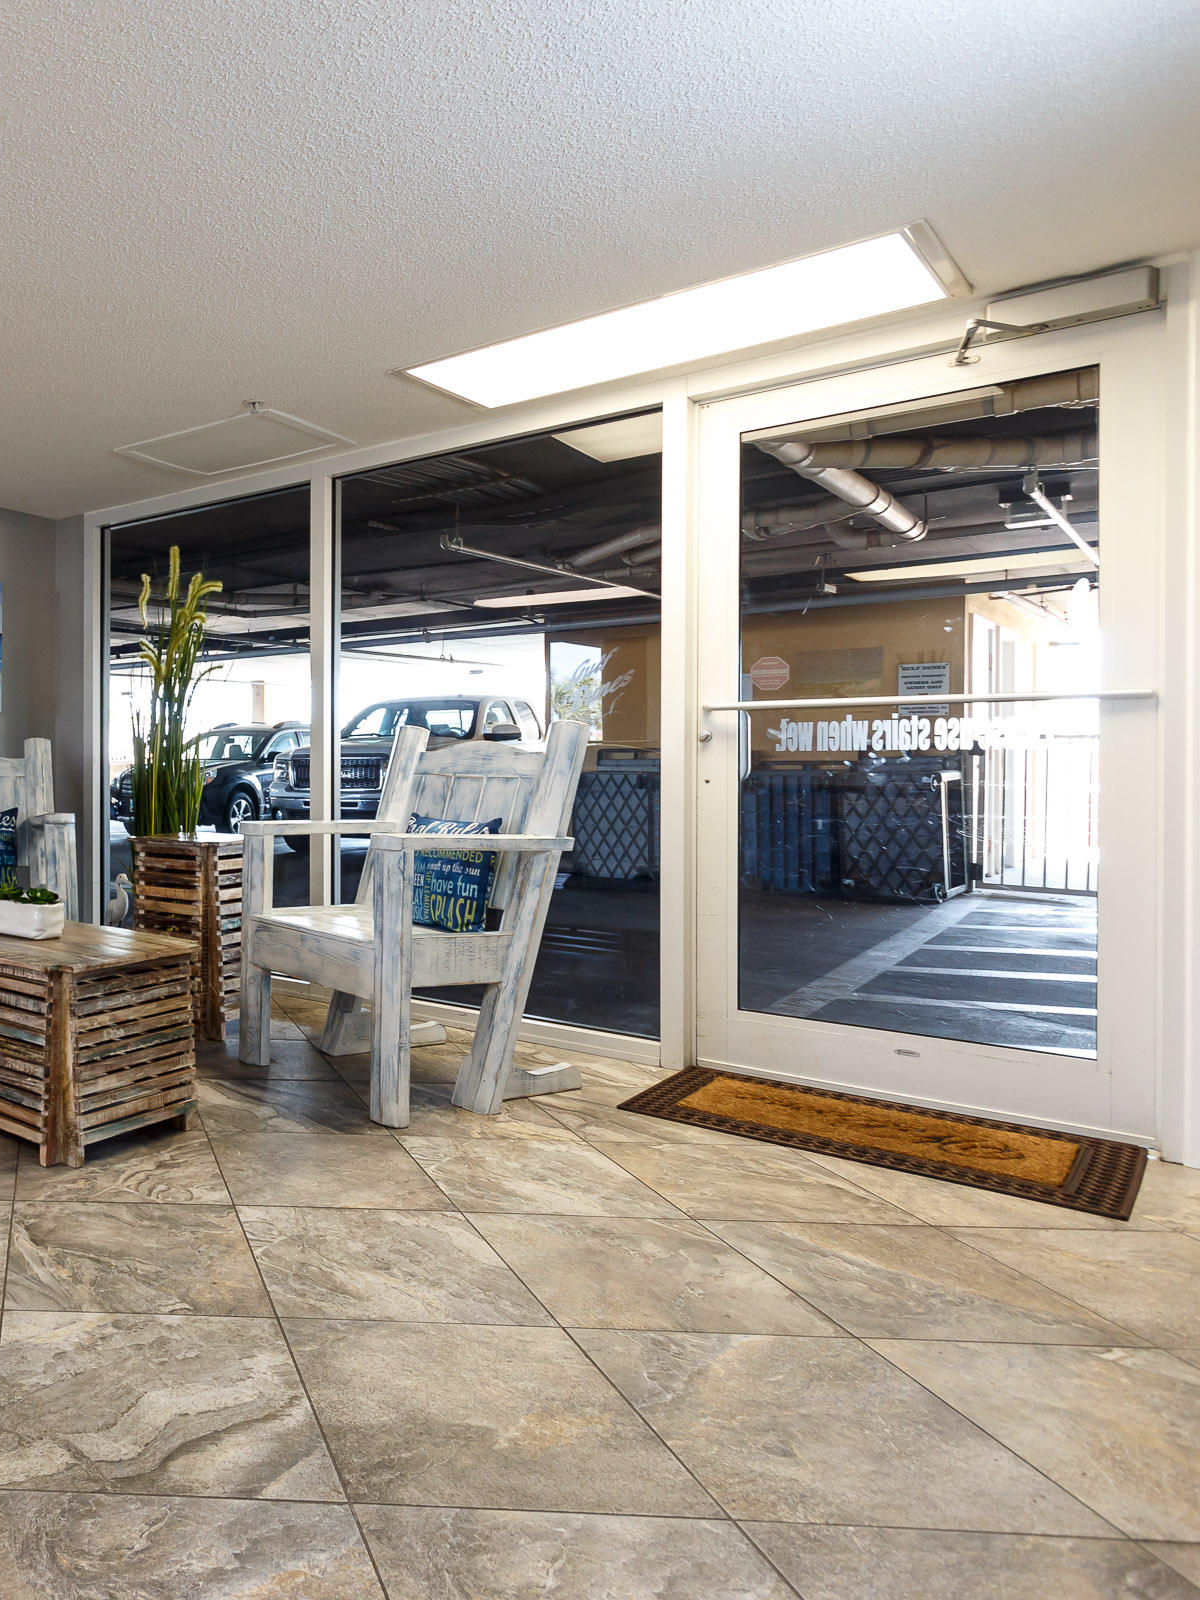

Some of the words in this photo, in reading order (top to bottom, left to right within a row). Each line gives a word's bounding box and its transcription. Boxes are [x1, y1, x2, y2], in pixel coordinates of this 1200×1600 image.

[430, 871, 454, 895] have
[457, 874, 479, 899] fun
[430, 894, 478, 933] SPLASH
